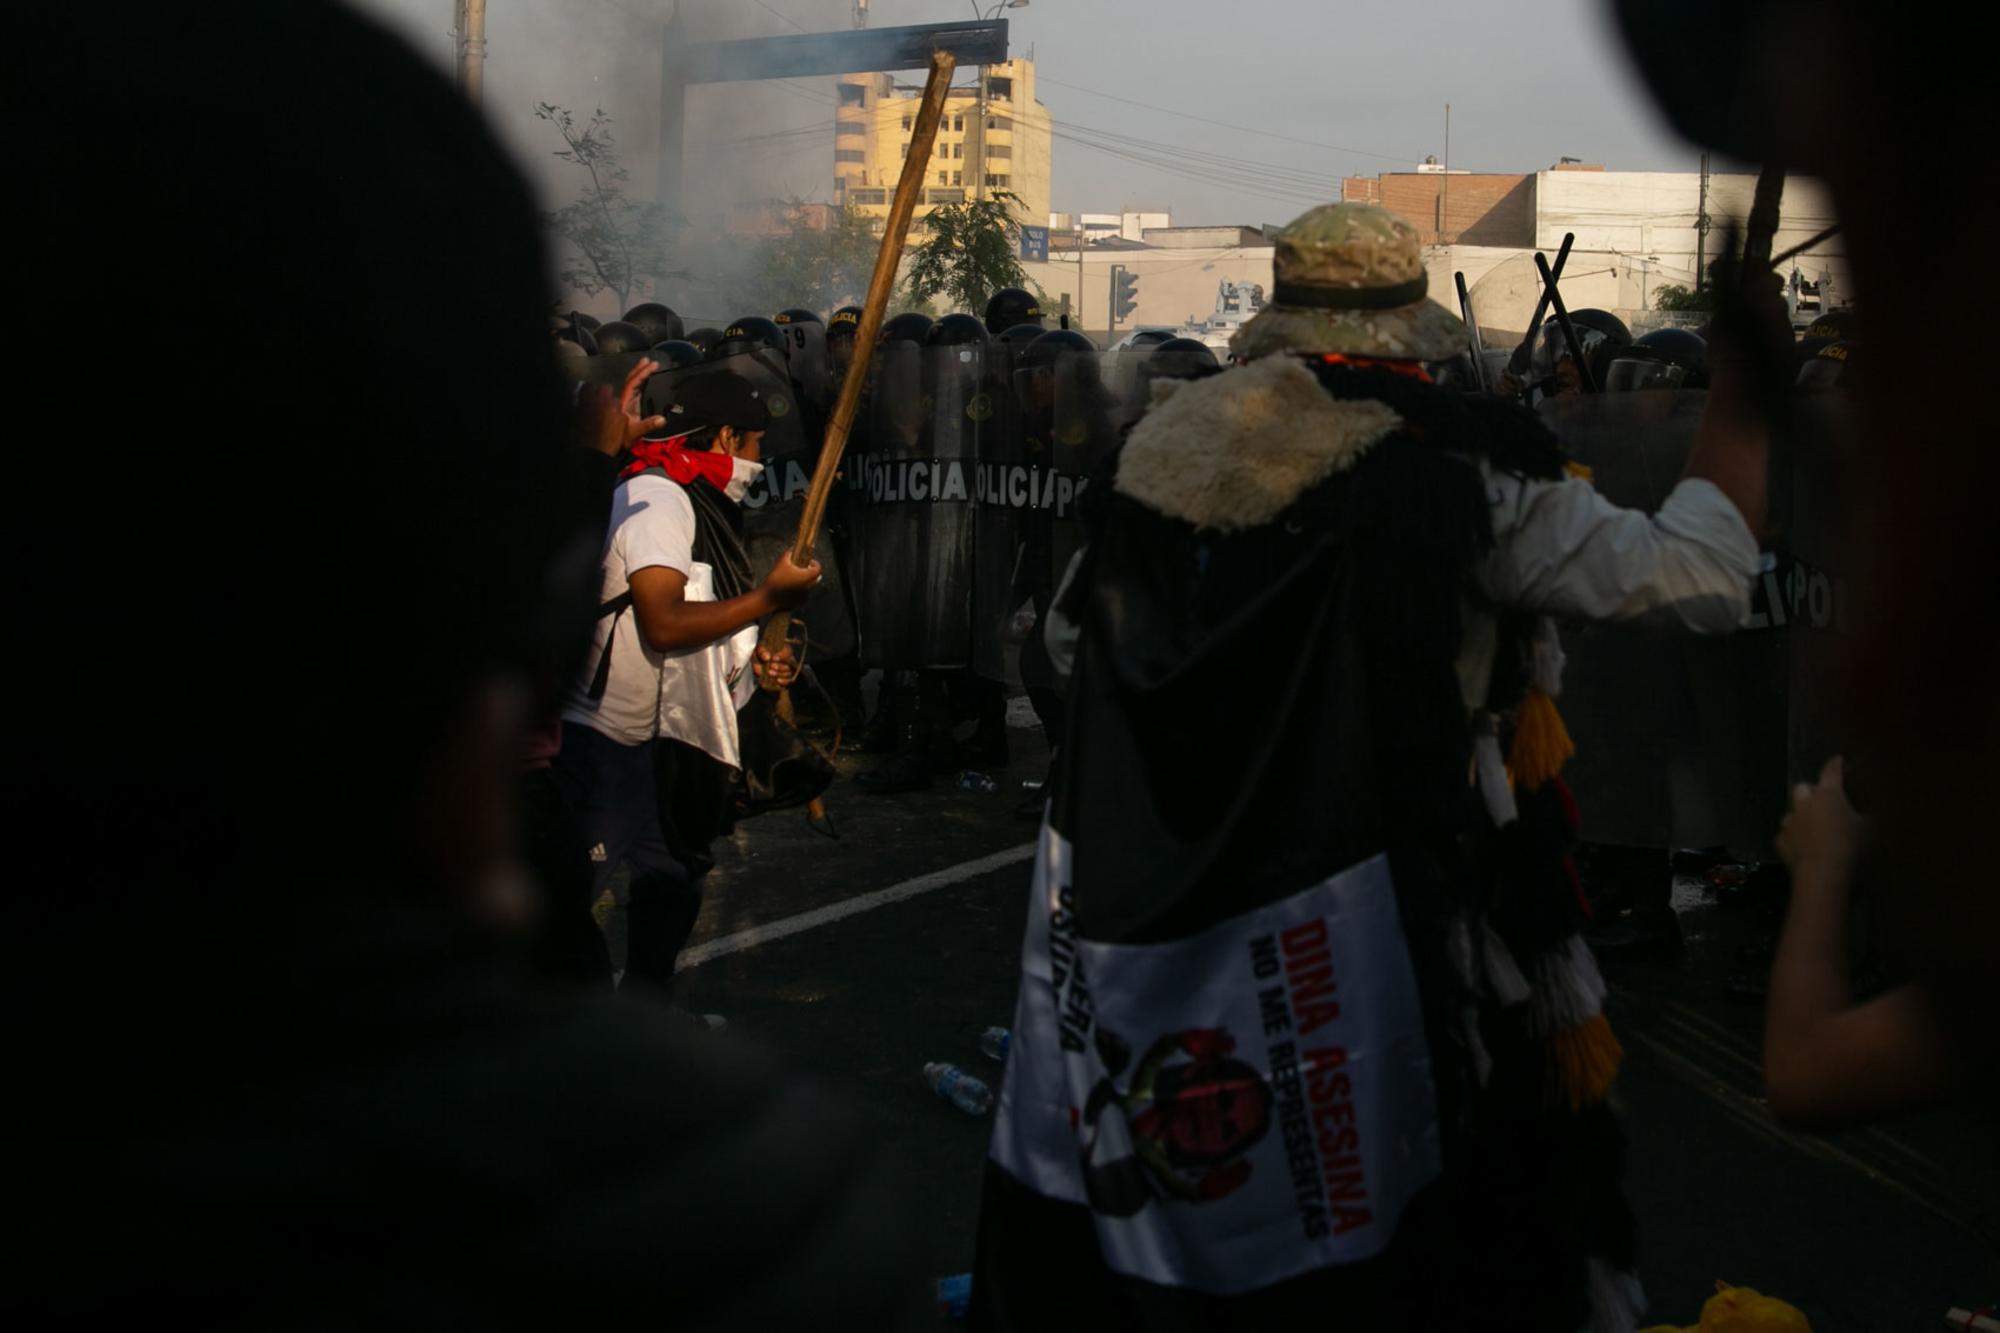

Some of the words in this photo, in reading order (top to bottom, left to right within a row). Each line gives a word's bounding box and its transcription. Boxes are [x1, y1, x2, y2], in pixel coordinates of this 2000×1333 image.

[1250, 934, 1280, 980] NO
[1259, 988, 1291, 1035] ME
[1281, 917, 1341, 1036] DINA
[1269, 1041, 1330, 1239] REPRESENTAS
[1303, 1047, 1375, 1237] ASESINA
